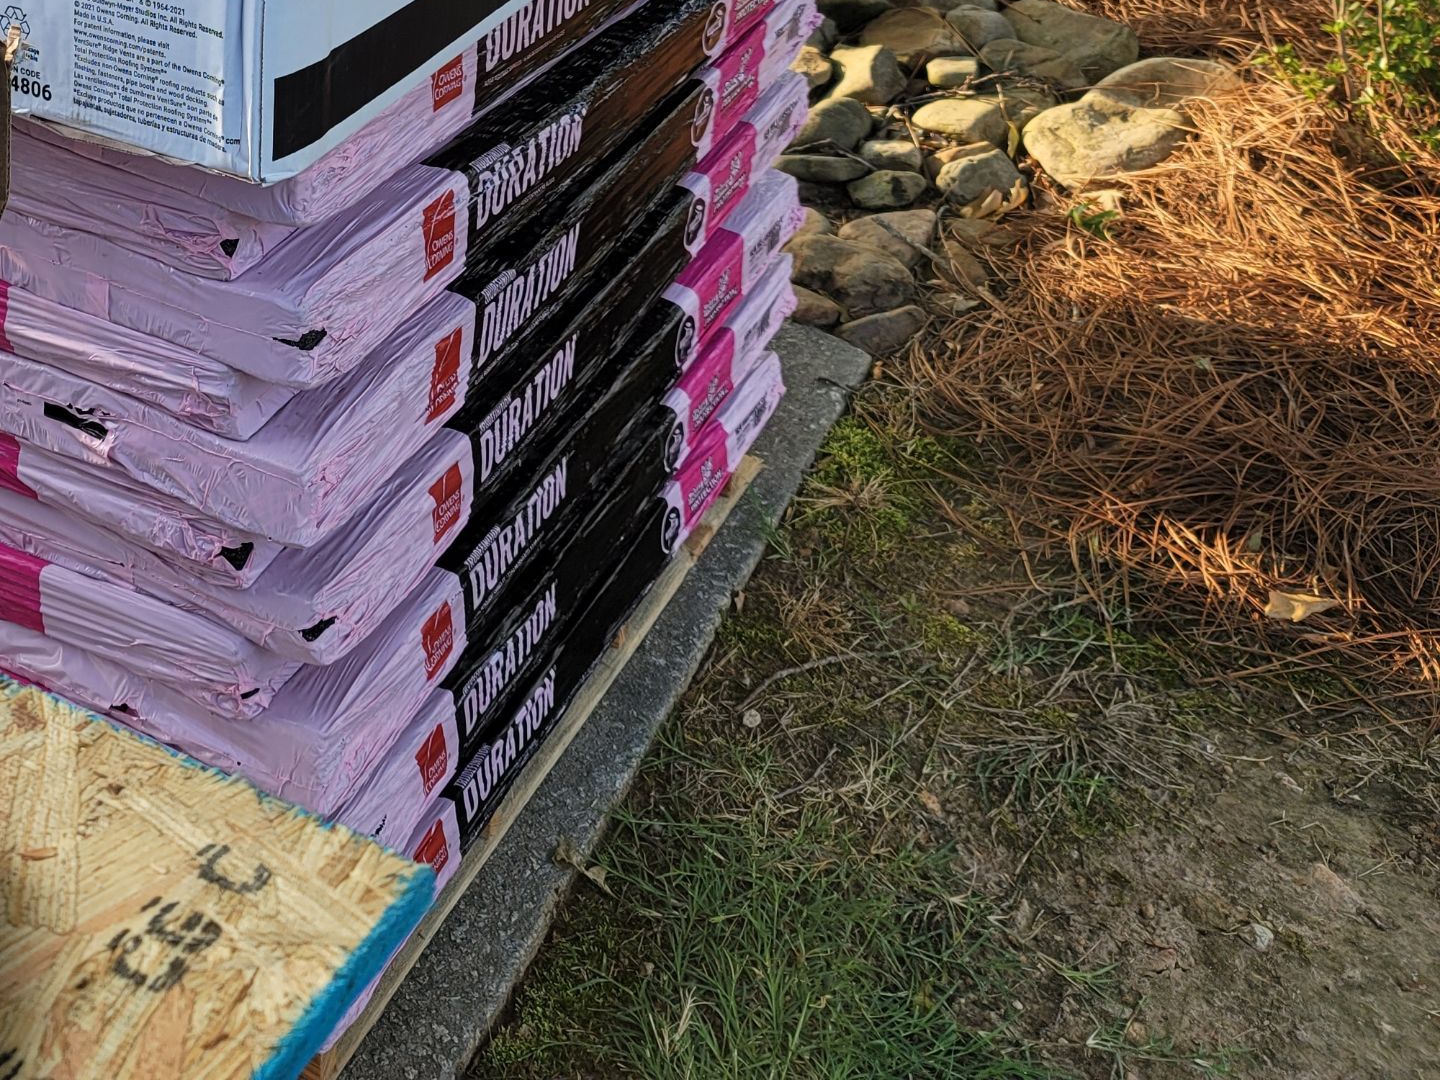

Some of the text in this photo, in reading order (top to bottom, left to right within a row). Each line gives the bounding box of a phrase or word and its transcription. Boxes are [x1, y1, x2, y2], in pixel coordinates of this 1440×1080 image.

[10, 76, 52, 102] 4806
[20, 68, 41, 80] CODE
[477, 222, 581, 369] DURATION
[480, 340, 577, 484] DURATION
[469, 457, 568, 611] DURATION
[464, 583, 557, 738] DURATION
[463, 672, 556, 824] DURATION
